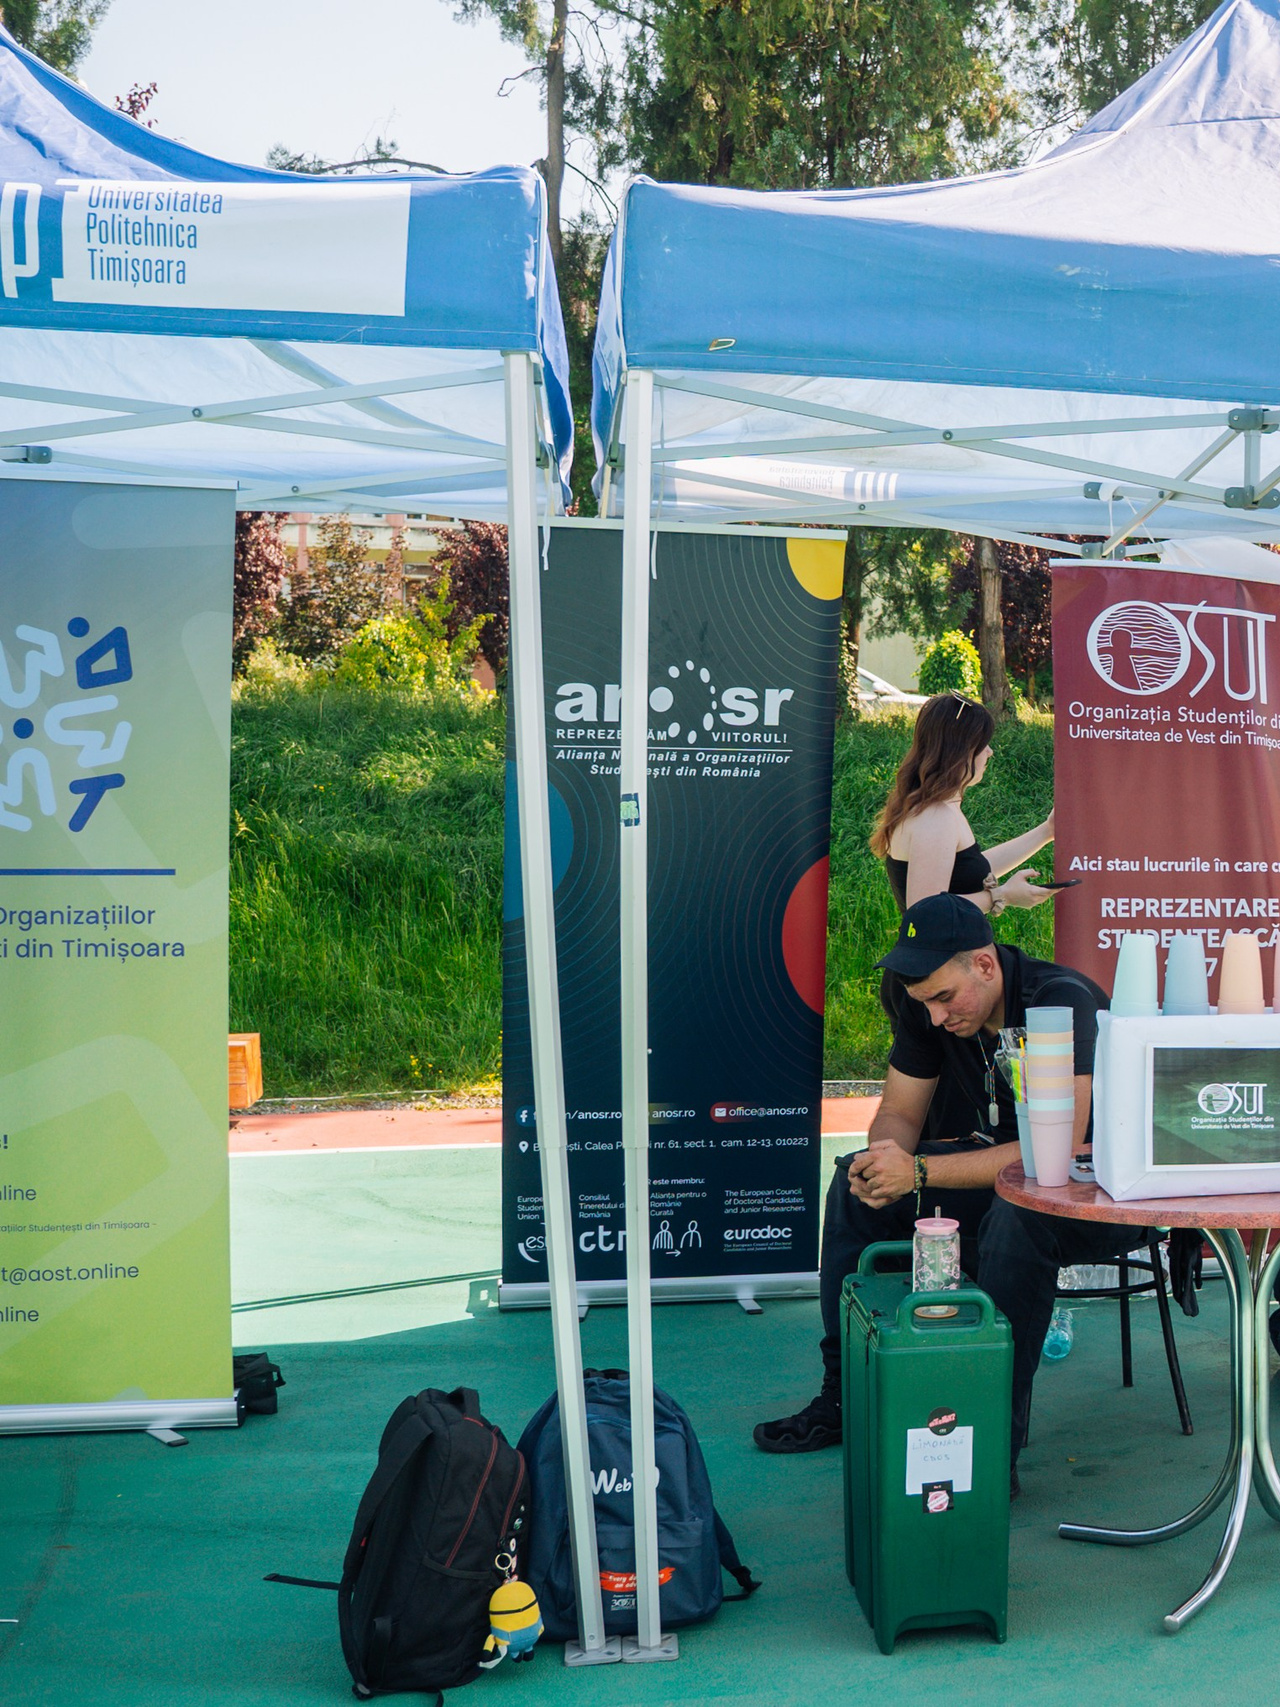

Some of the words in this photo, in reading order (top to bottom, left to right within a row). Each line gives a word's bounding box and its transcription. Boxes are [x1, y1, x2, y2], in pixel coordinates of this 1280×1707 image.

[88, 185, 223, 214] Universitatea
[86, 212, 198, 249] Politehnica
[87, 248, 187, 287] Timișoara
[1069, 701, 1171, 725] Organizația
[1178, 706, 1267, 728] Studenților
[556, 728, 667, 741] REPREZEĂM
[712, 731, 787, 743] VIITORUL!
[1069, 724, 1161, 741] Universitatea
[1164, 728, 1183, 742] de
[1186, 729, 1216, 744] Vest
[1220, 730, 1241, 745] din
[556, 749, 606, 762] Alianța
[611, 751, 677, 762] Nnală
[683, 754, 690, 762] a
[696, 751, 790, 765] Organizațiilor
[590, 764, 670, 778] Studești
[675, 766, 697, 777] din
[702, 766, 761, 778] România
[1069, 856, 1102, 871] Aici
[1106, 858, 1140, 872] stau
[1144, 856, 1210, 872] lucrurile
[1213, 858, 1230, 872] în
[1234, 860, 1268, 873] care
[1100, 898, 1280, 918] REPREZENTARE
[16, 939, 53, 958] din
[62, 938, 185, 964] Timișoara
[728, 1106, 809, 1118] office@anosr.ro
[584, 1141, 613, 1150] Calea
[654, 1141, 666, 1149] nr.
[684, 1139, 706, 1149] sect.
[721, 1139, 744, 1148] cam.
[775, 1137, 809, 1146] 010223
[671, 1177, 705, 1185] membru:
[517, 1196, 544, 1204] Europe
[650, 1192, 675, 1200] Alianța
[676, 1192, 700, 1200] pentru
[724, 1189, 739, 1197] The
[740, 1189, 774, 1198] European
[579, 1202, 618, 1210] Tineretului
[733, 1197, 764, 1205] Doctoral
[517, 1213, 540, 1221] Union
[579, 1211, 611, 1219] România
[739, 1206, 761, 1214] Junior
[28, 1223, 83, 1234] Studențești
[85, 1222, 100, 1232] din
[103, 1221, 150, 1231] Timișoara
[723, 1225, 792, 1240] eurodoc
[2, 1263, 139, 1285] t@aost.online
